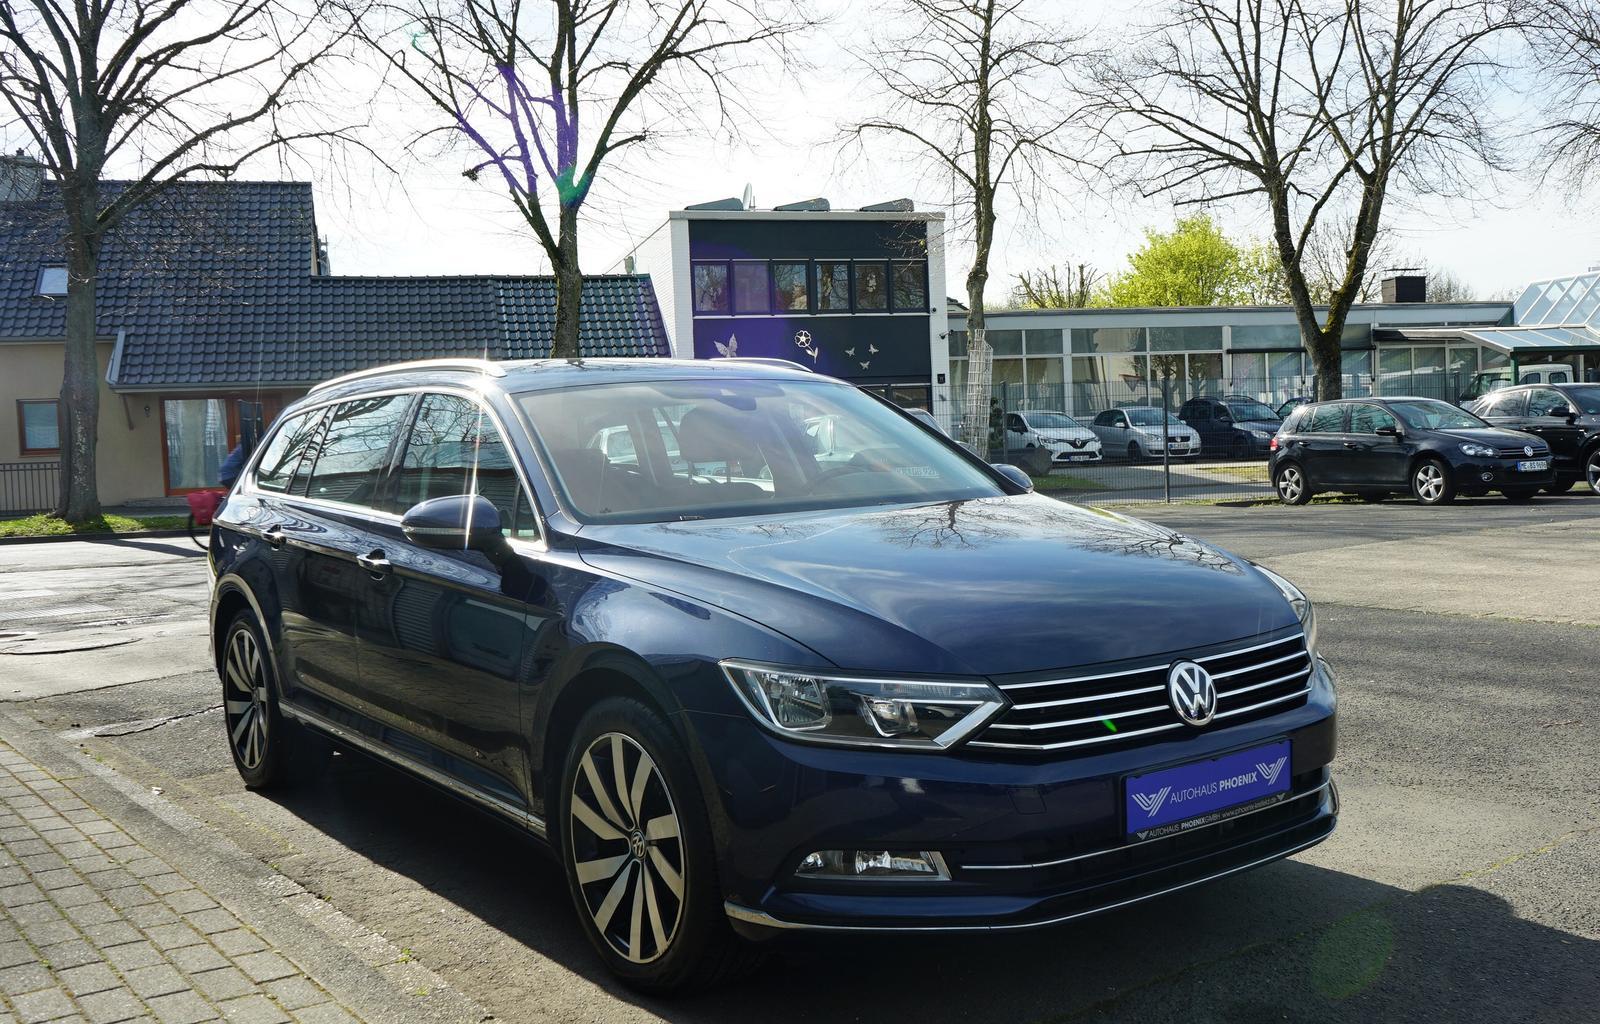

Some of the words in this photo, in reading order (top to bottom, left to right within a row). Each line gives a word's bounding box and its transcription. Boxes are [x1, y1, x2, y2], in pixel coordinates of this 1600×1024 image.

[1170, 783, 1218, 804] AUTOHAUS
[1219, 771, 1258, 791] PHOENIX
[1149, 825, 1180, 837] AUTOHAUS
